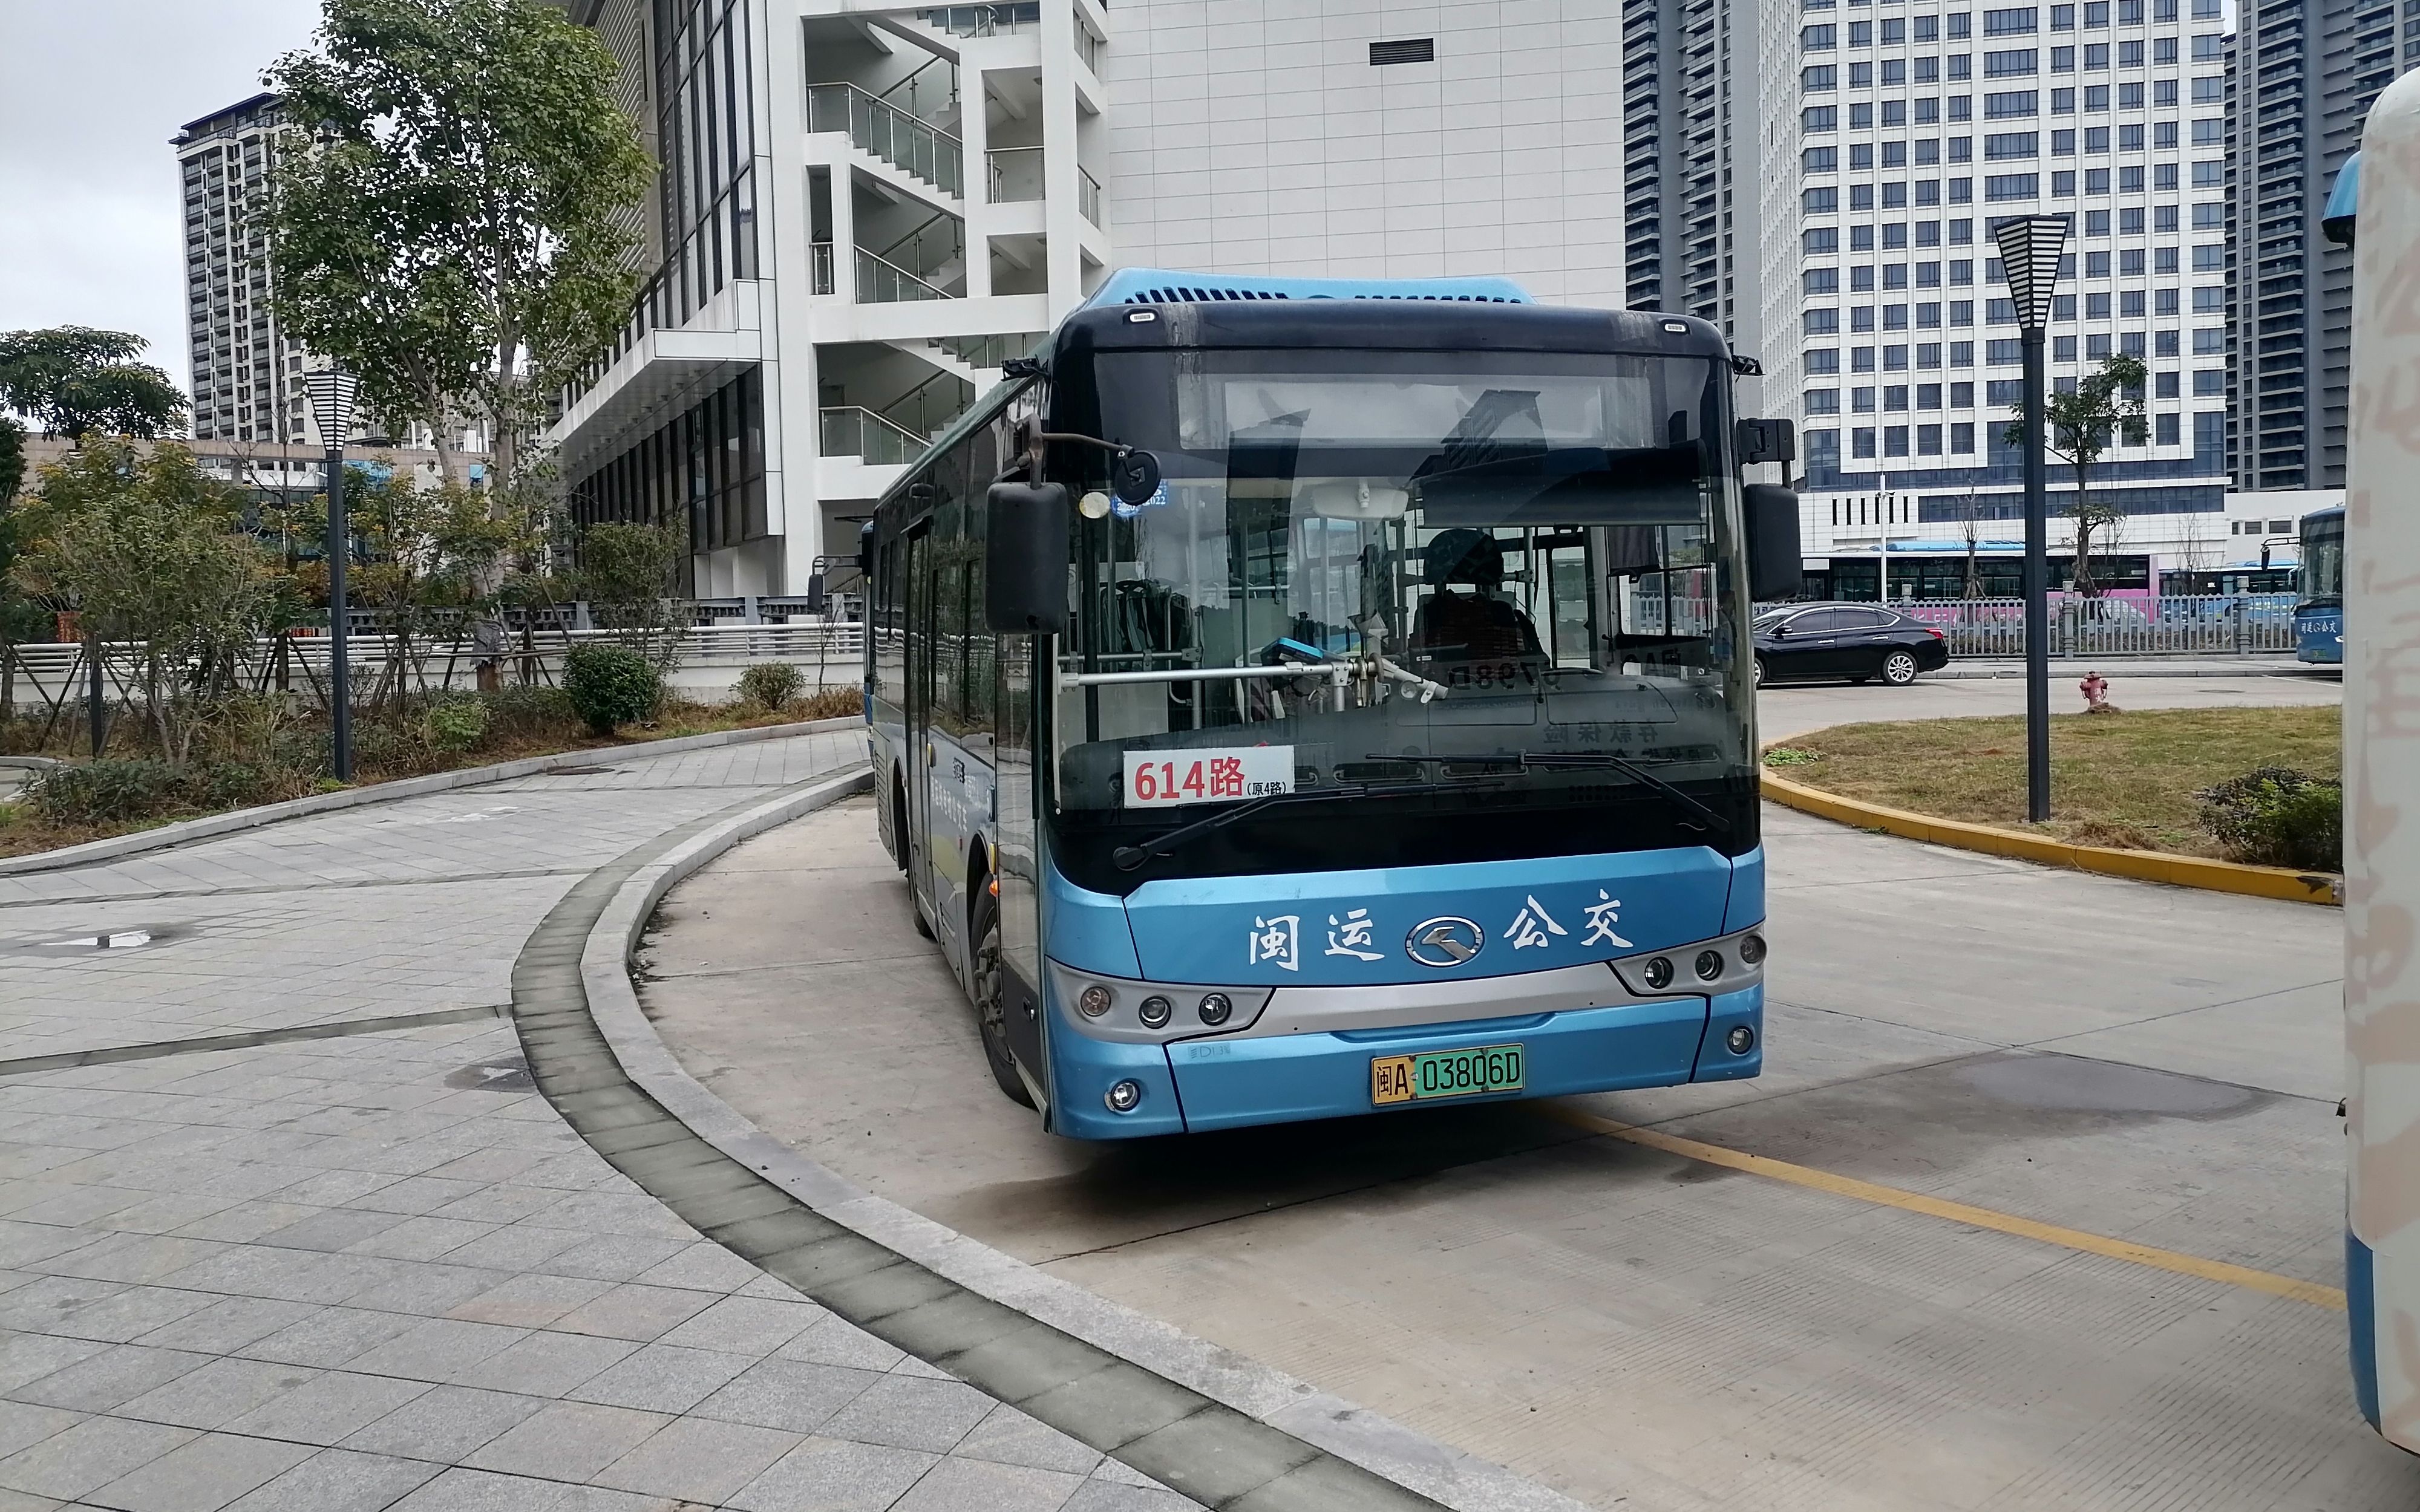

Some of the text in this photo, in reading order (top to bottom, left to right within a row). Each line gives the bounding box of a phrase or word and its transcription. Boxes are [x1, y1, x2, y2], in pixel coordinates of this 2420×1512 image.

[2321, 620, 2337, 633] 公交
[1135, 757, 1287, 800] 614路 (原4路)
[1249, 888, 1634, 971] 闽运 公交
